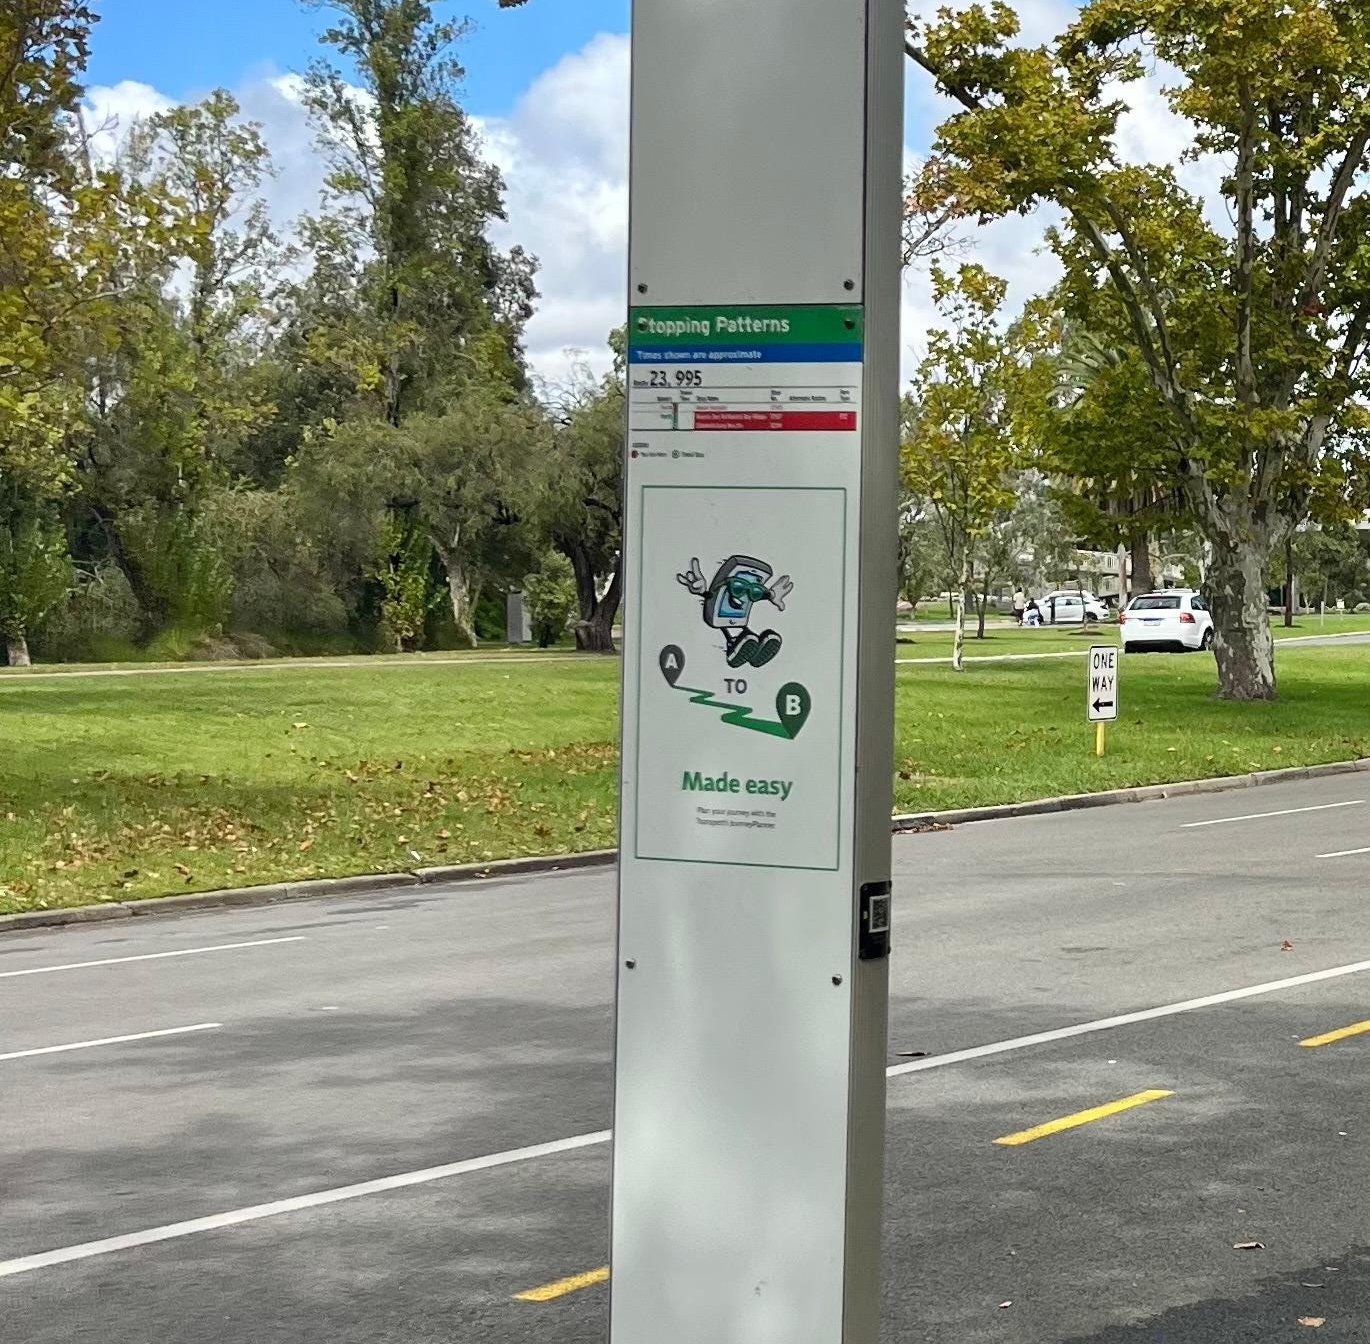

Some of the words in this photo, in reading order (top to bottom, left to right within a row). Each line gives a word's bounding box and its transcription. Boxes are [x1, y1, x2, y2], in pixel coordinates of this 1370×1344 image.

[715, 316, 790, 333] Patterns
[675, 370, 703, 387] 995
[664, 654, 678, 669] A
[1093, 653, 1114, 669] ONE
[724, 678, 748, 694] TO
[1092, 675, 1115, 692] WAY
[785, 694, 801, 716] B
[682, 770, 740, 793] Made
[746, 779, 793, 801] easy
